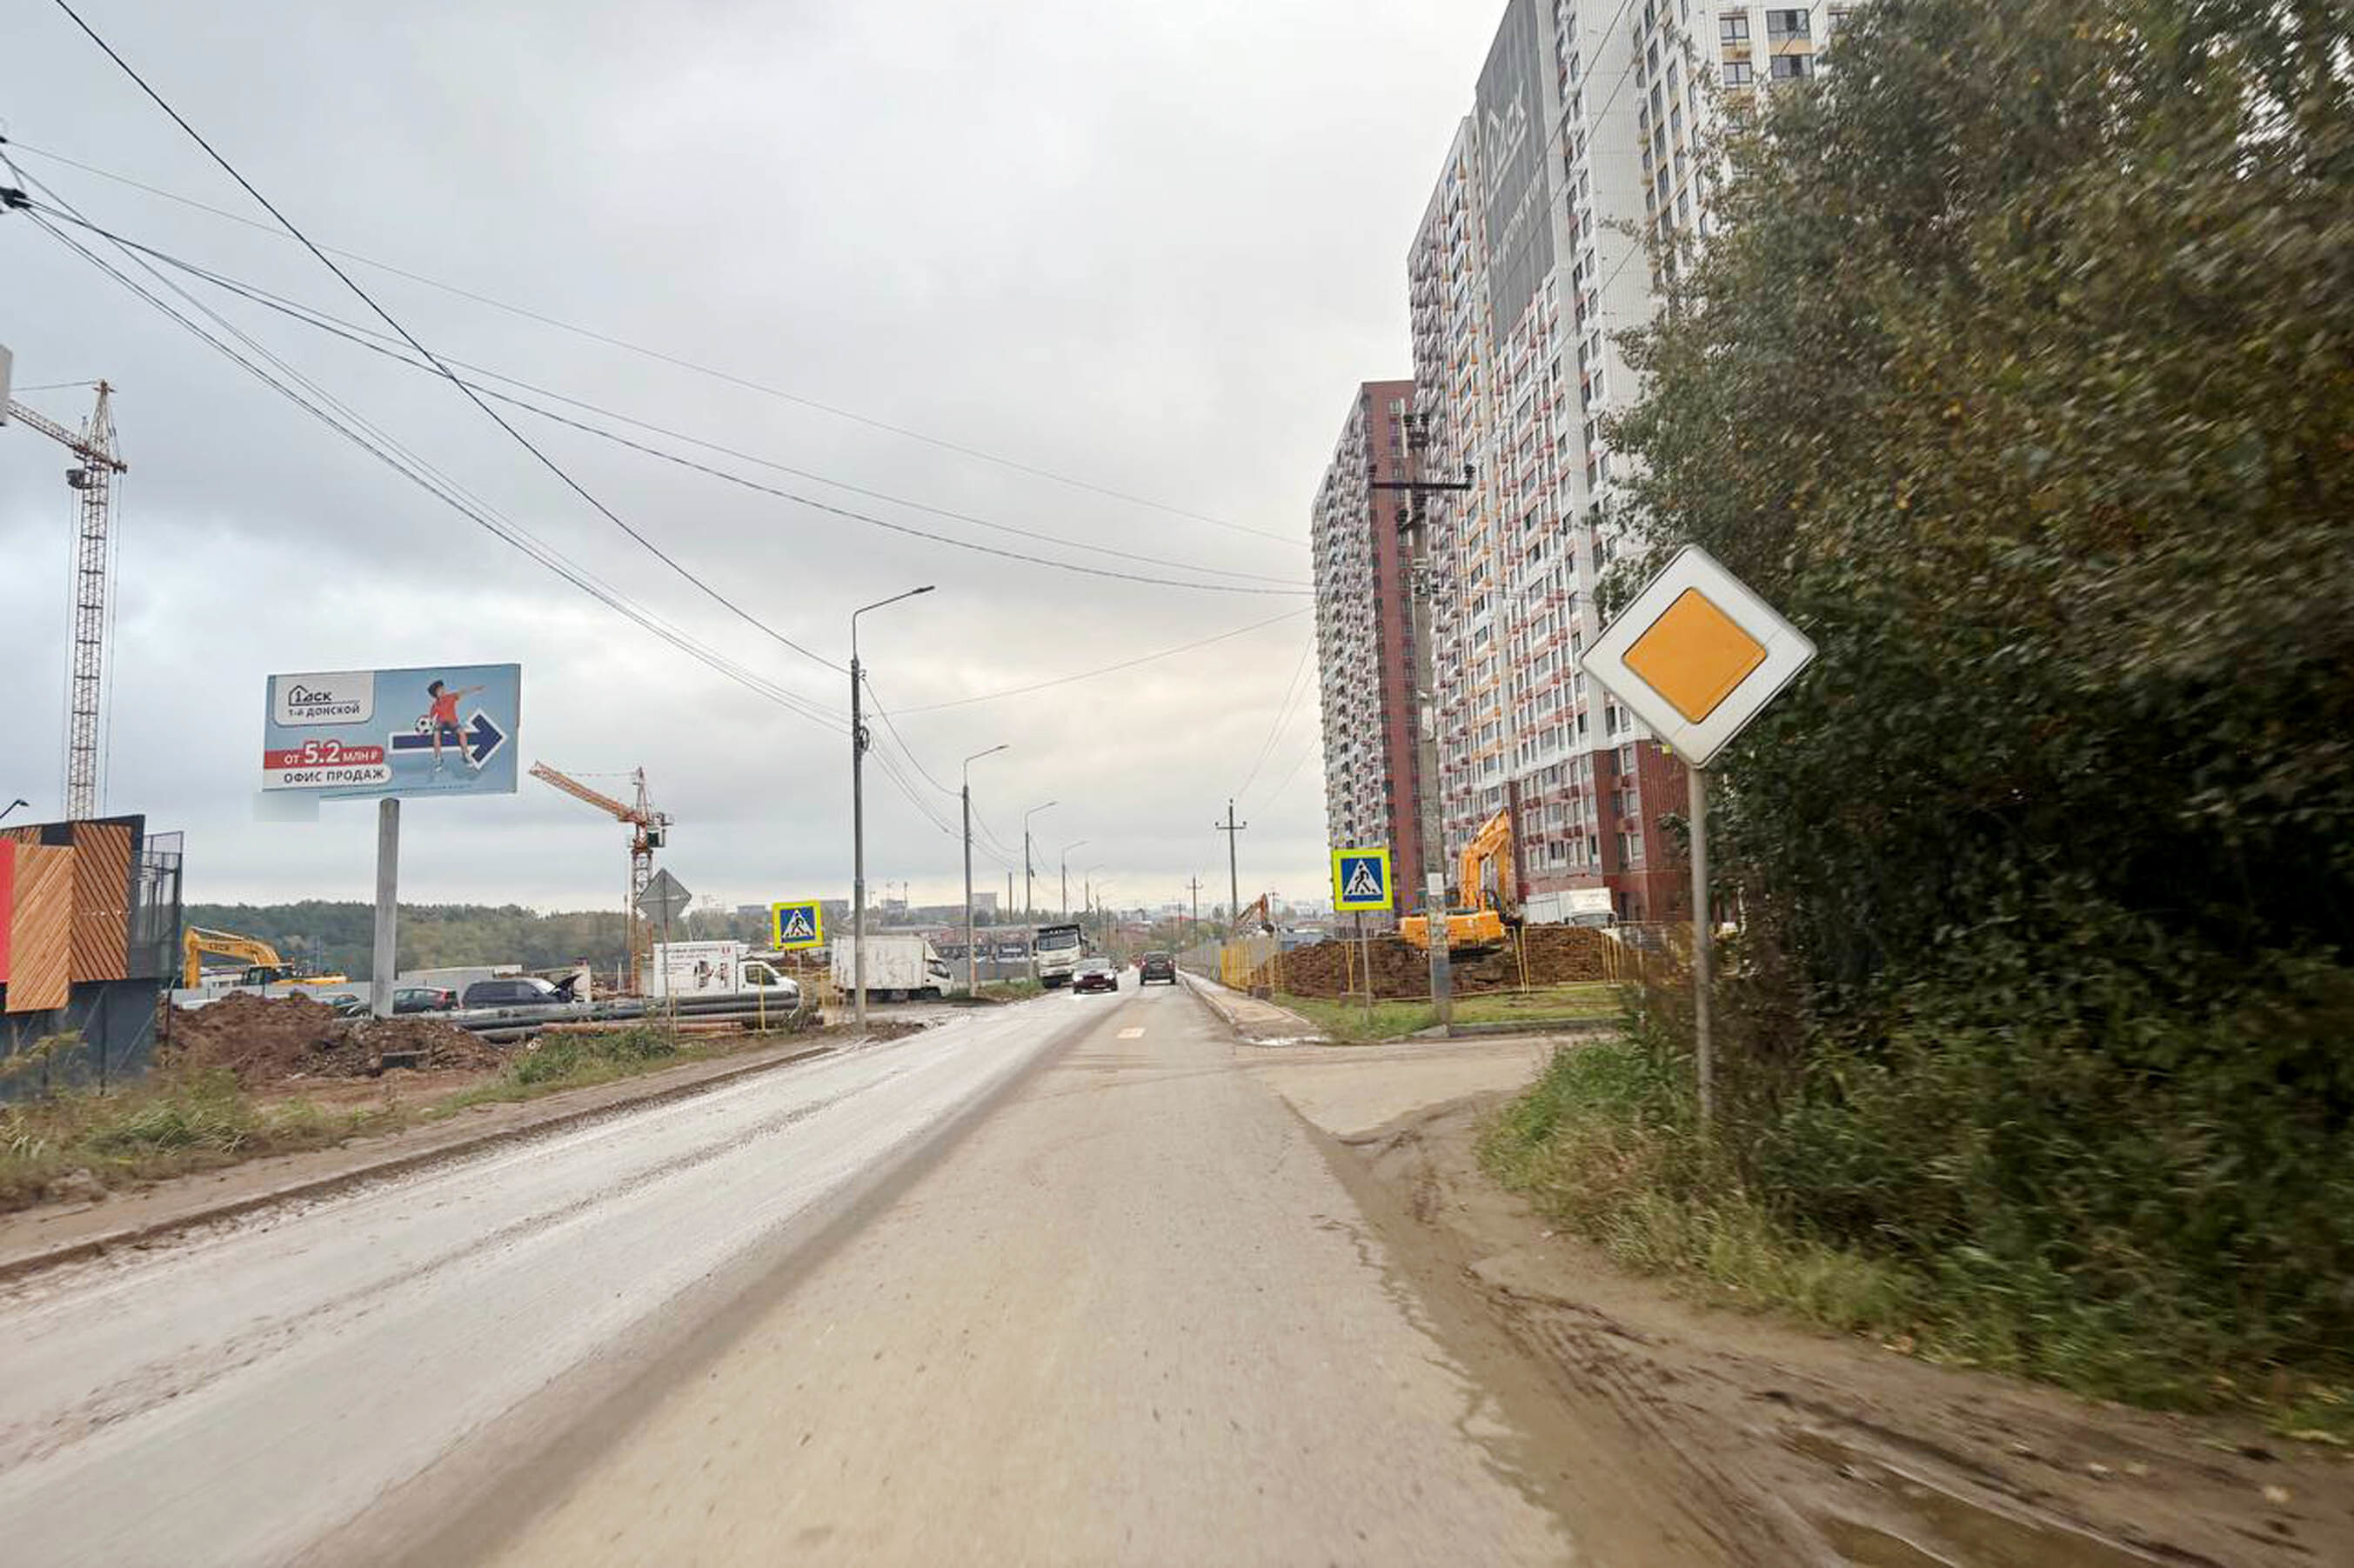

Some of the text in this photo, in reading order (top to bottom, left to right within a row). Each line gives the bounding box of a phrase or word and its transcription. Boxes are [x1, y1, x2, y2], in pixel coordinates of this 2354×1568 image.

[306, 704, 360, 717] ДОНСКОЙ
[304, 742, 340, 764] 5.2
[284, 769, 385, 784] ОФИС ПРОДАЖ
